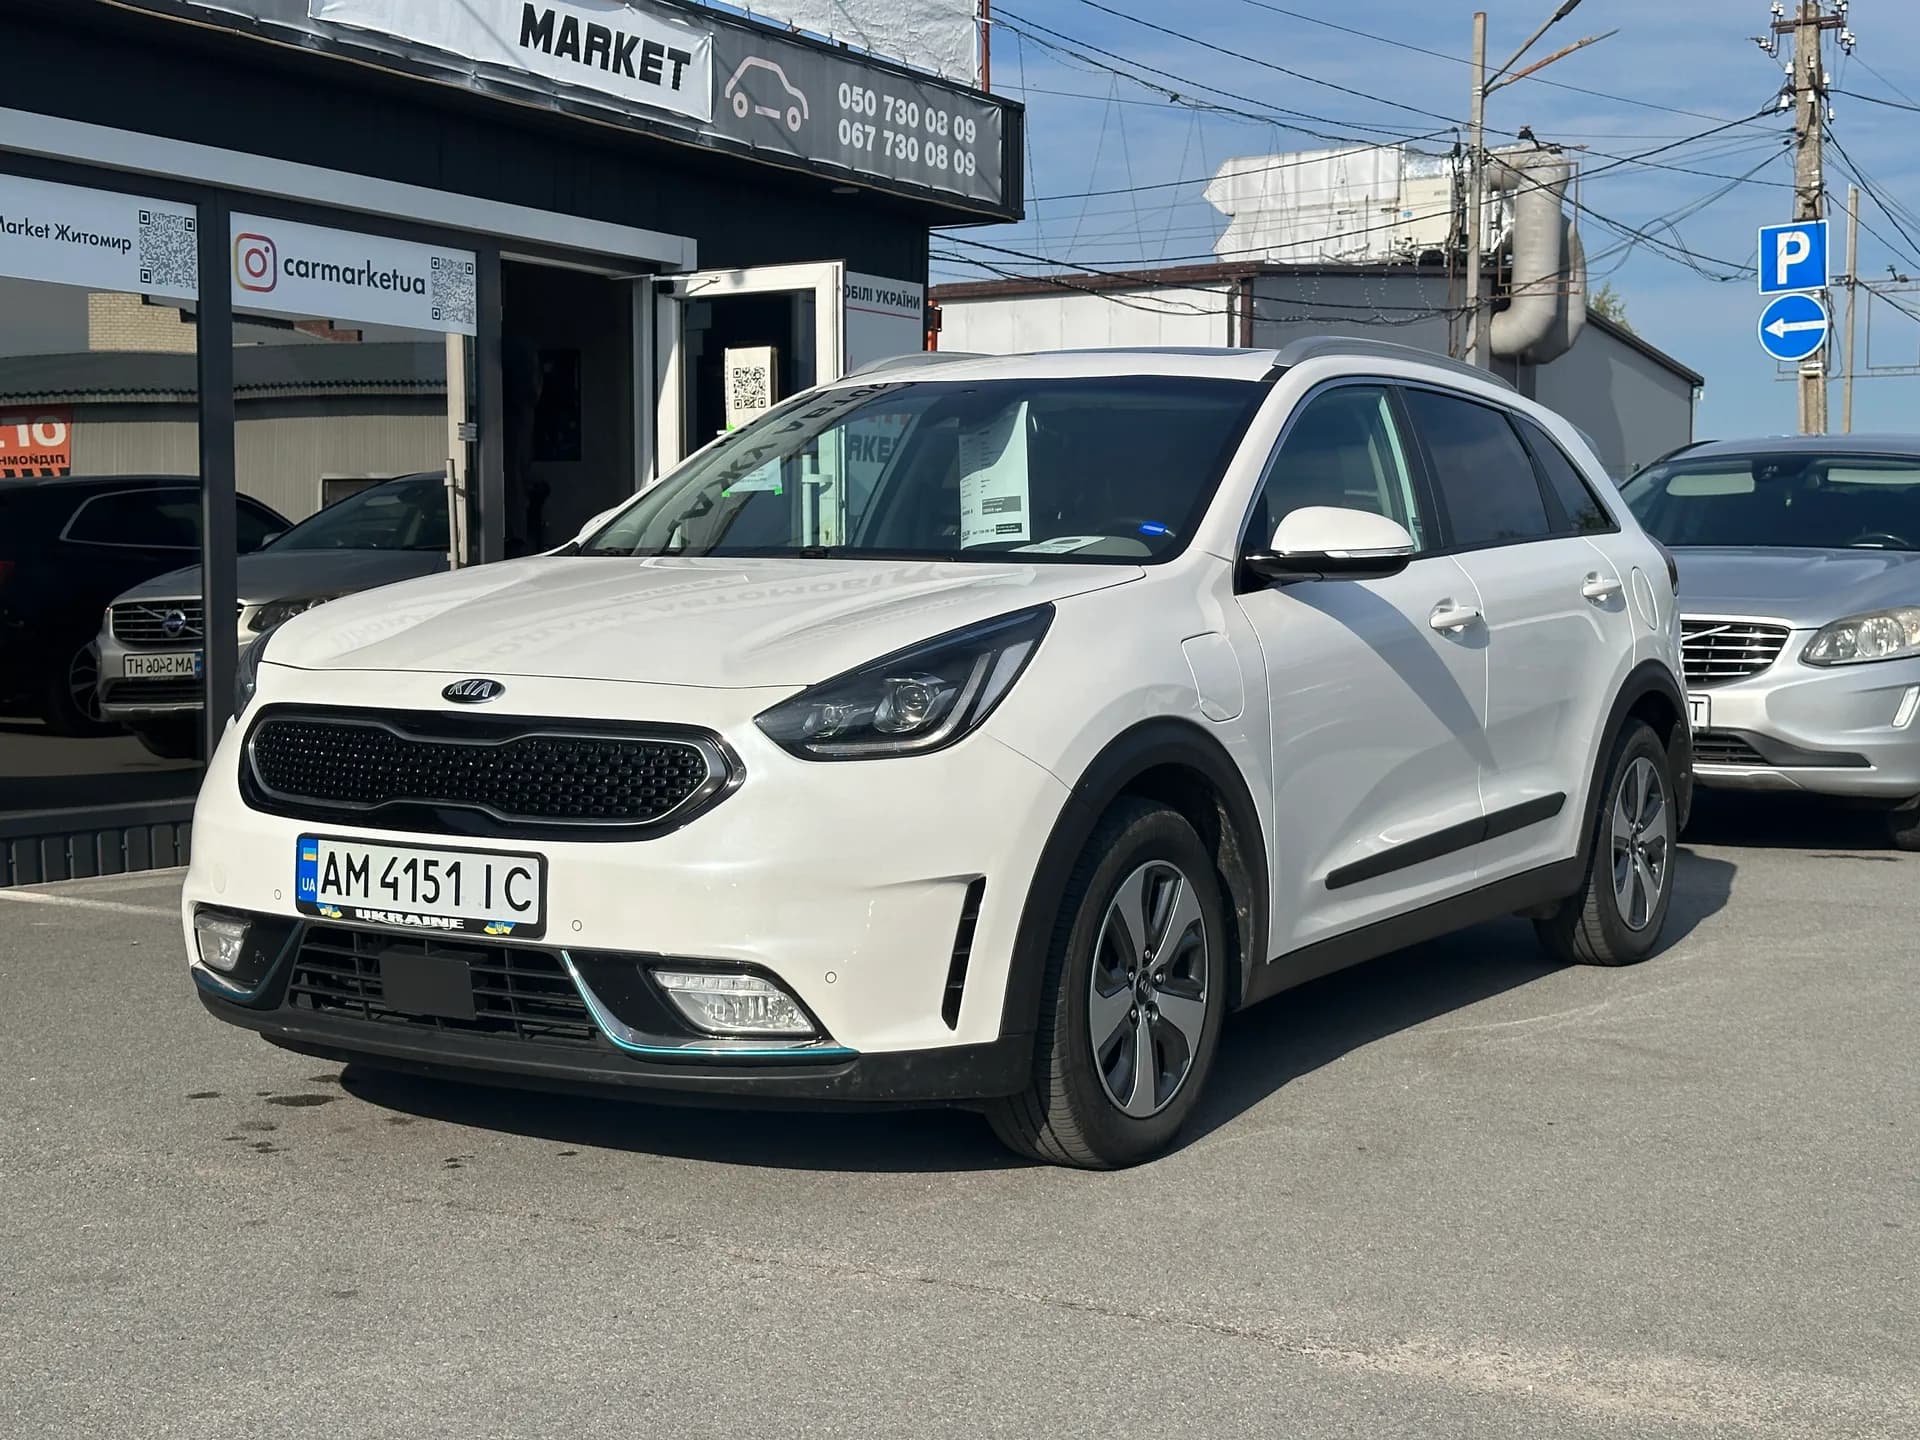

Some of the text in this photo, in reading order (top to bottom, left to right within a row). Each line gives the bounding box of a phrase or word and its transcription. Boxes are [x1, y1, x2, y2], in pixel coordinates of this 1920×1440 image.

[519, 2, 691, 91] MARKET
[838, 82, 976, 144] 050 730 08 09
[838, 118, 976, 177] 067 730 08 09
[54, 223, 132, 255] Житомир
[1776, 231, 1811, 285] P
[283, 257, 426, 295] carmarketua
[875, 289, 920, 310] УКРАЇНИ
[447, 680, 493, 698] KIA
[302, 877, 316, 892] UA
[320, 851, 532, 912] AM 4151 IC
[355, 908, 465, 930] UKRAINE
